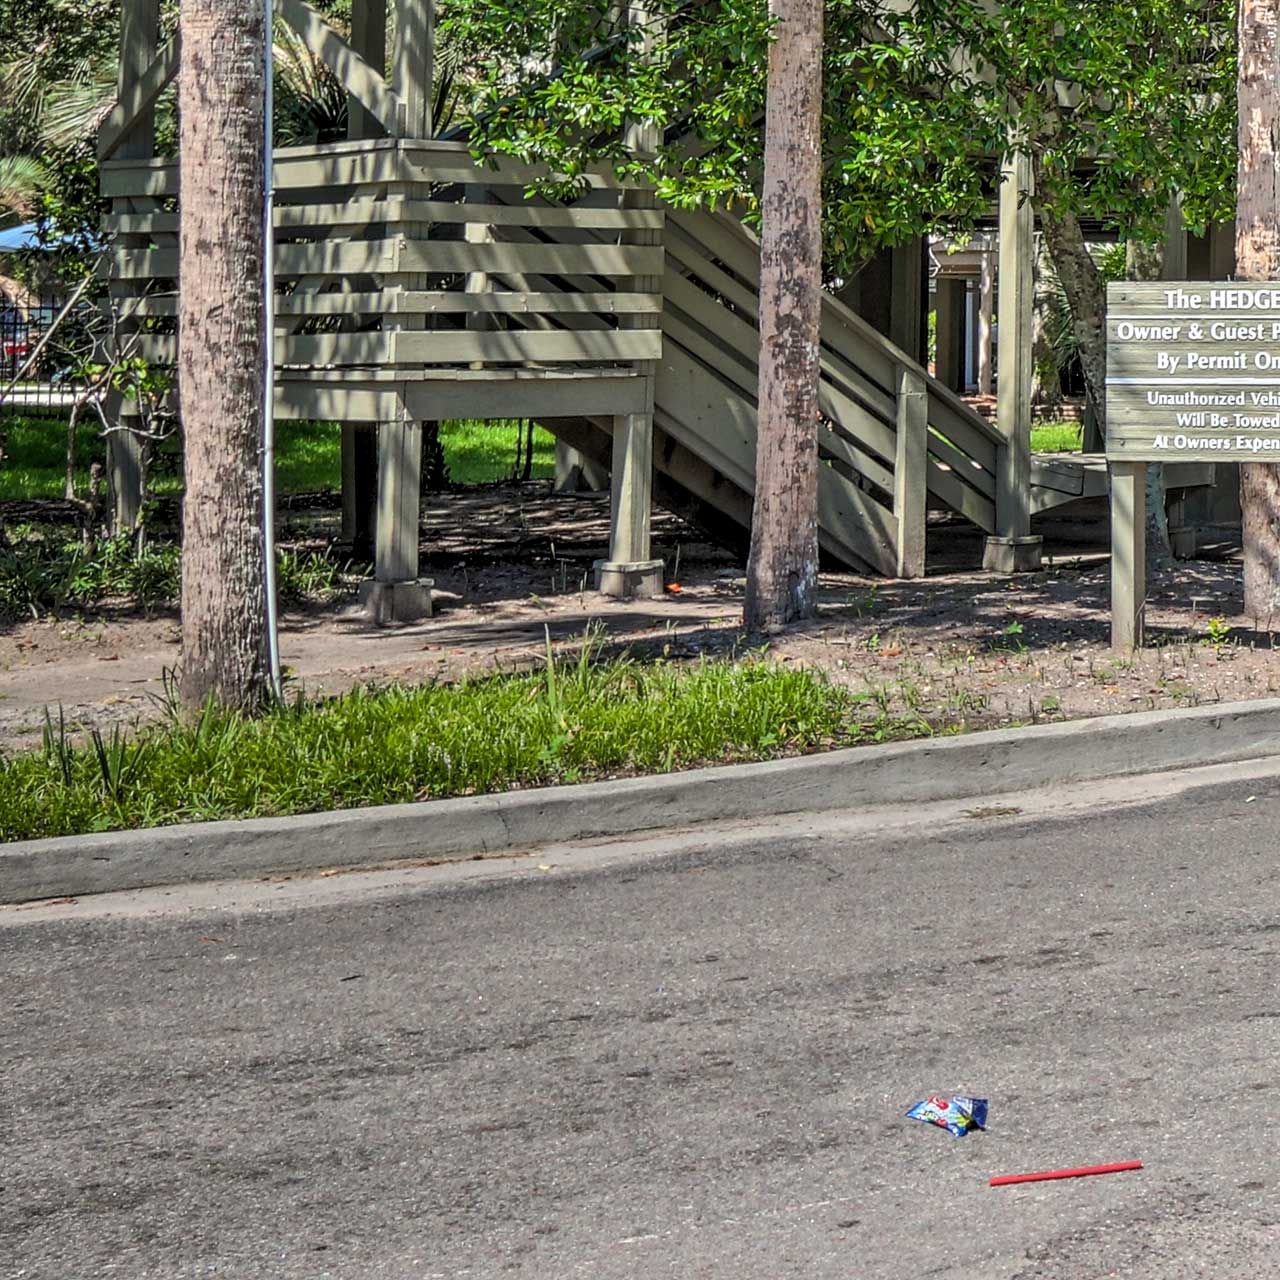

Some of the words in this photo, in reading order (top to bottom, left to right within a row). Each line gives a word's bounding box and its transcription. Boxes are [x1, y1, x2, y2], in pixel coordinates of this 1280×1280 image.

[1163, 290, 1202, 309] The
[1117, 322, 1181, 341] Owner
[1188, 323, 1203, 340] &
[1210, 322, 1265, 340] Guest
[1156, 352, 1180, 374] By
[1187, 351, 1248, 370] Permit
[1146, 391, 1246, 407] Unauthorized
[1176, 412, 1206, 428] Will
[1210, 414, 1229, 428] Be
[1233, 413, 1280, 429] Towed
[1152, 435, 1169, 449] At
[1173, 434, 1232, 450] Owners
